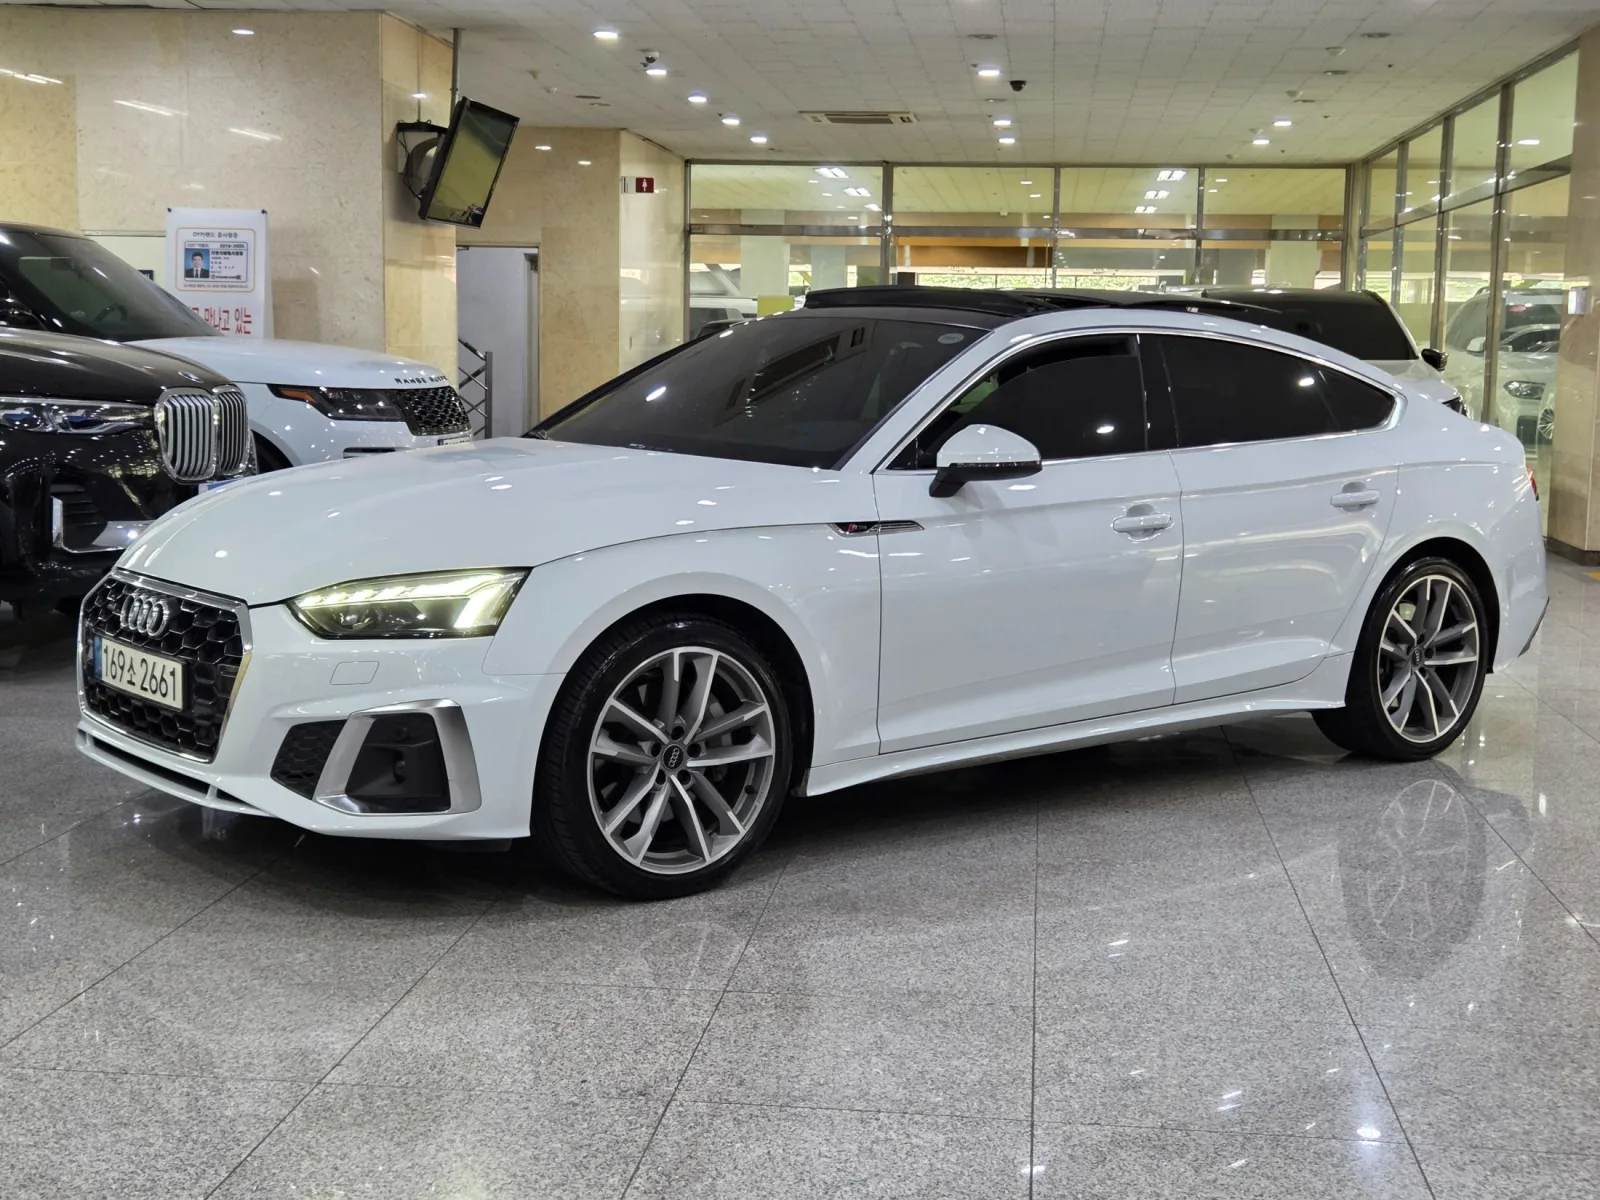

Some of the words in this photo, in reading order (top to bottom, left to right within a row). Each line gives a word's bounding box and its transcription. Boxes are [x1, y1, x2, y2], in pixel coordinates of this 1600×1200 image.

[235, 306, 252, 334] 있는
[428, 375, 448, 383] ROVER
[103, 645, 136, 686] 169소
[140, 657, 176, 702] 2661
